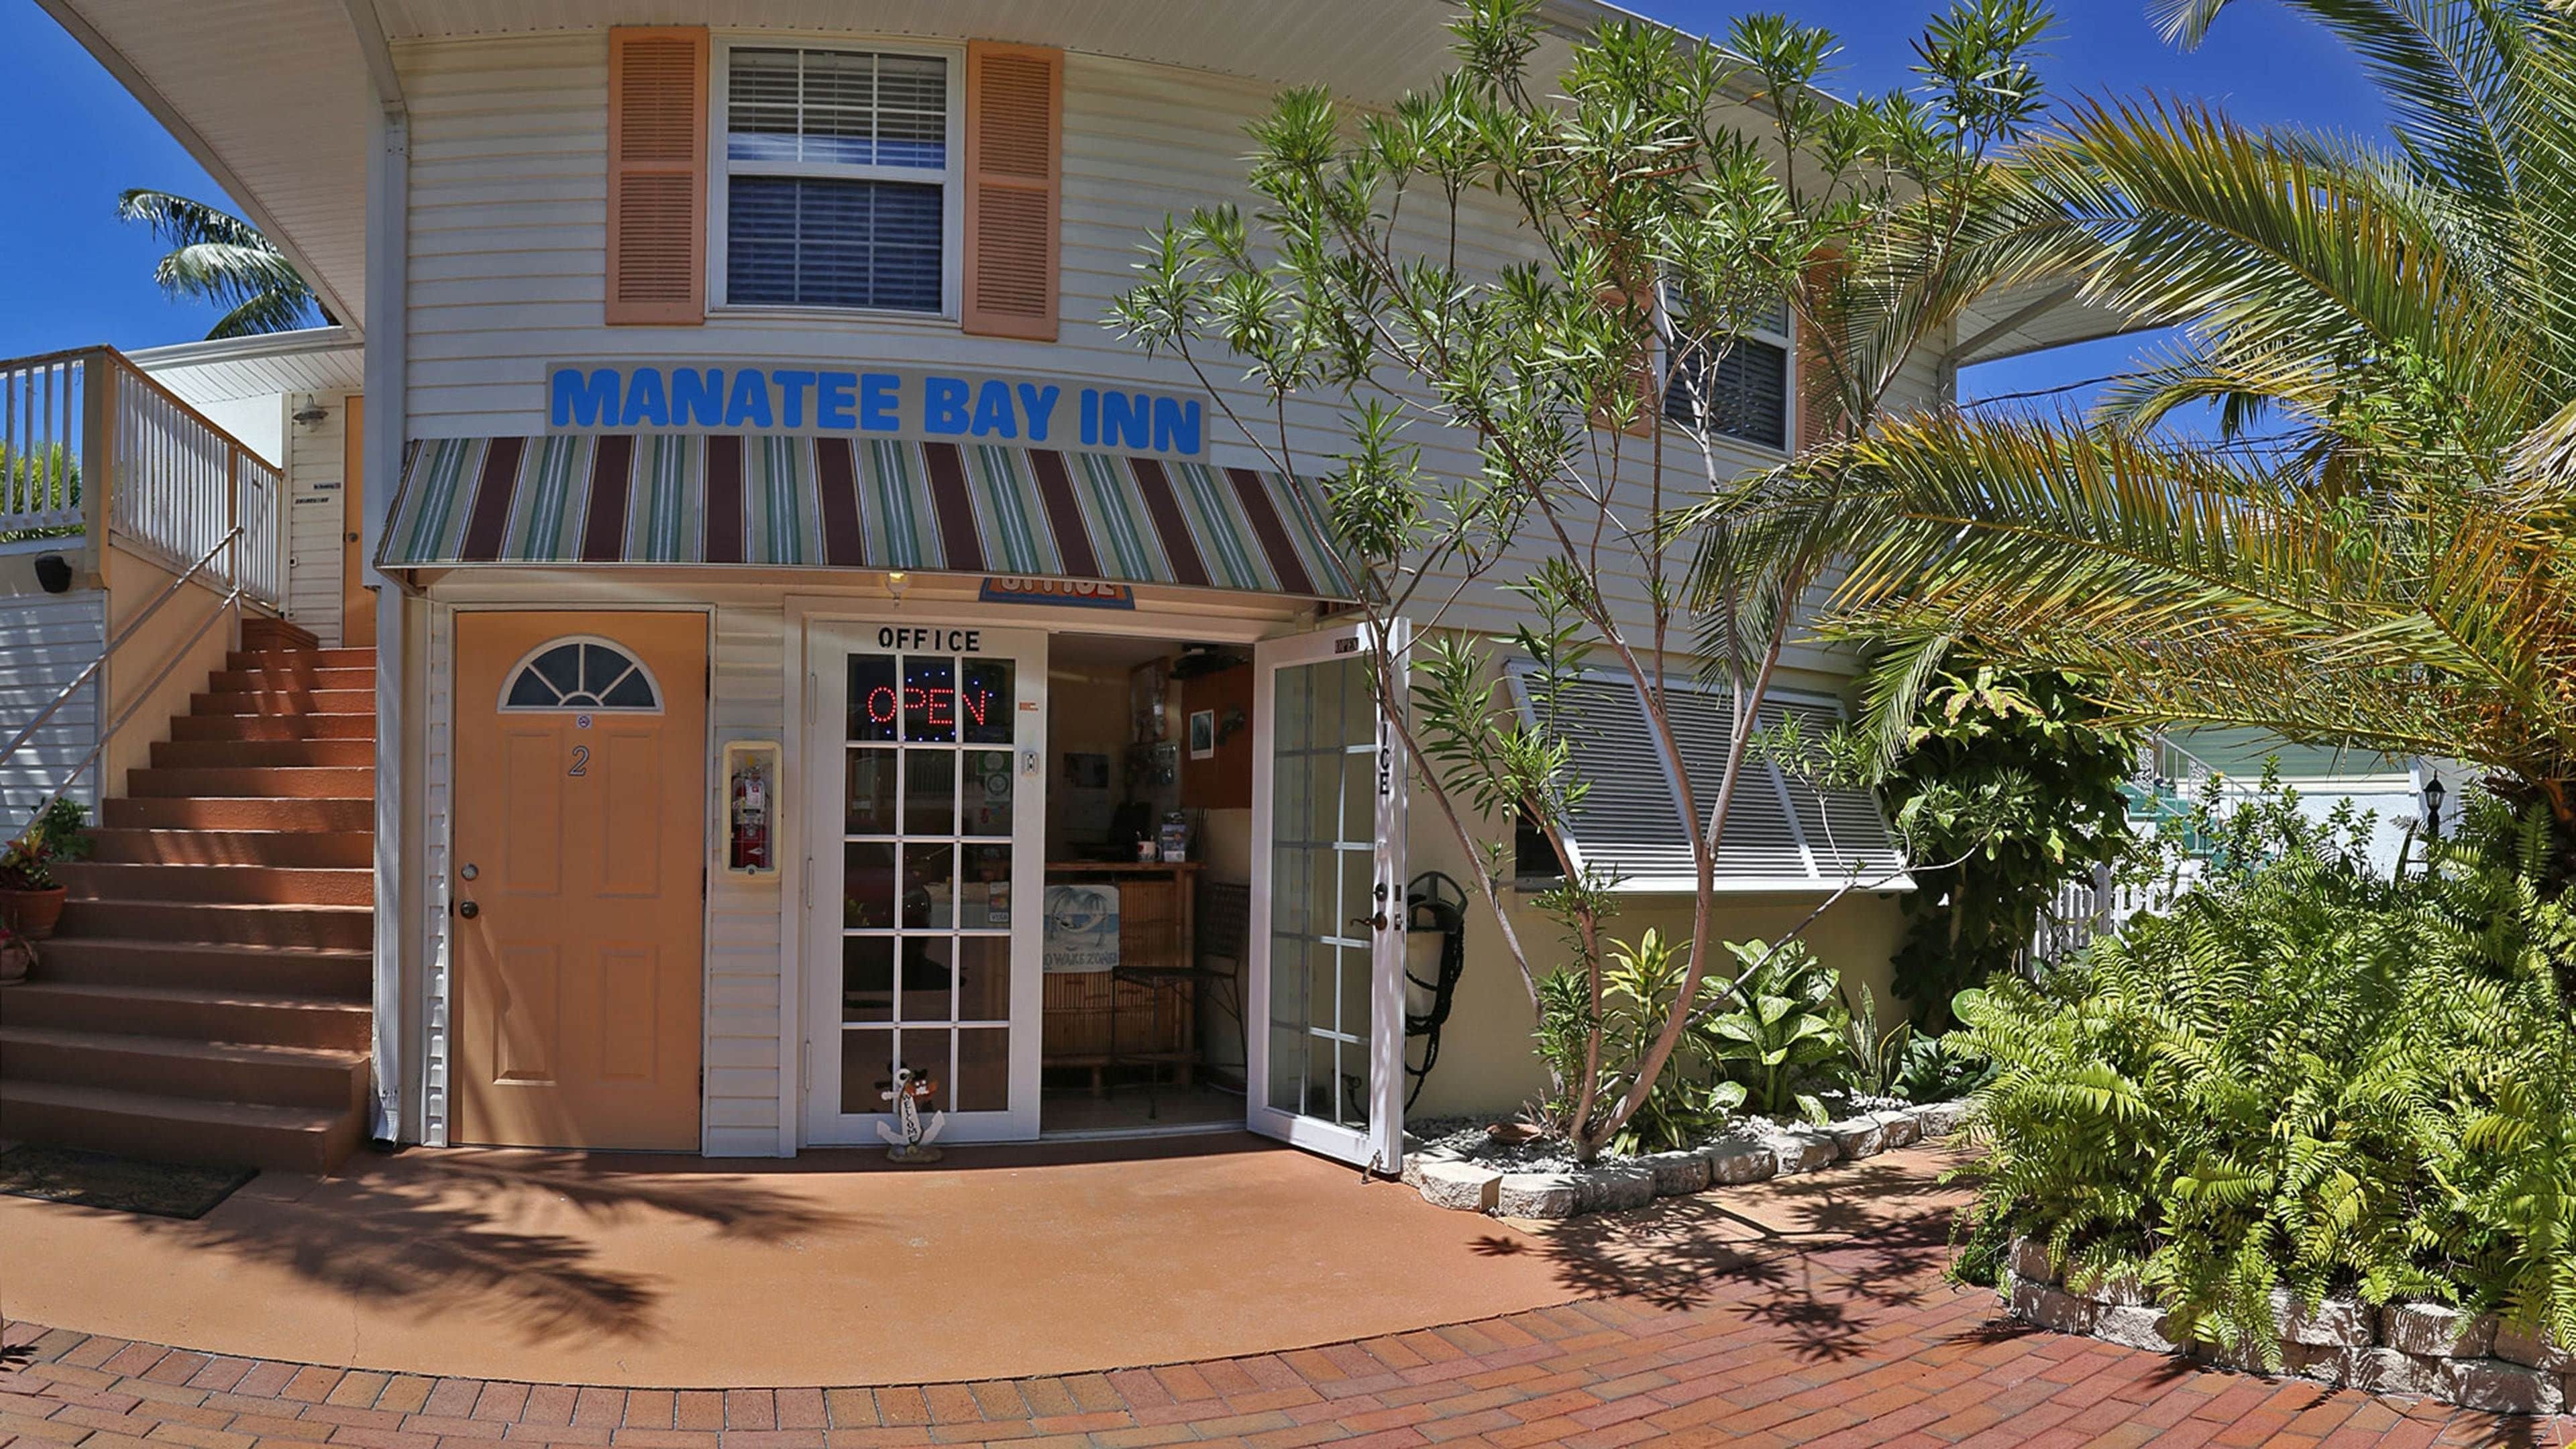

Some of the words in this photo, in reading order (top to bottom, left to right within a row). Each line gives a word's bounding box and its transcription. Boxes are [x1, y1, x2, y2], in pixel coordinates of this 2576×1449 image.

[551, 368, 900, 431] MANATEE
[924, 377, 1060, 441] BAY
[1080, 389, 1201, 454] INN
[877, 627, 980, 652] OFFICE
[1335, 637, 1359, 653] OPEN
[867, 686, 986, 726] OPEN
[568, 745, 590, 777] 2
[902, 1094, 918, 1144] WELCOME
